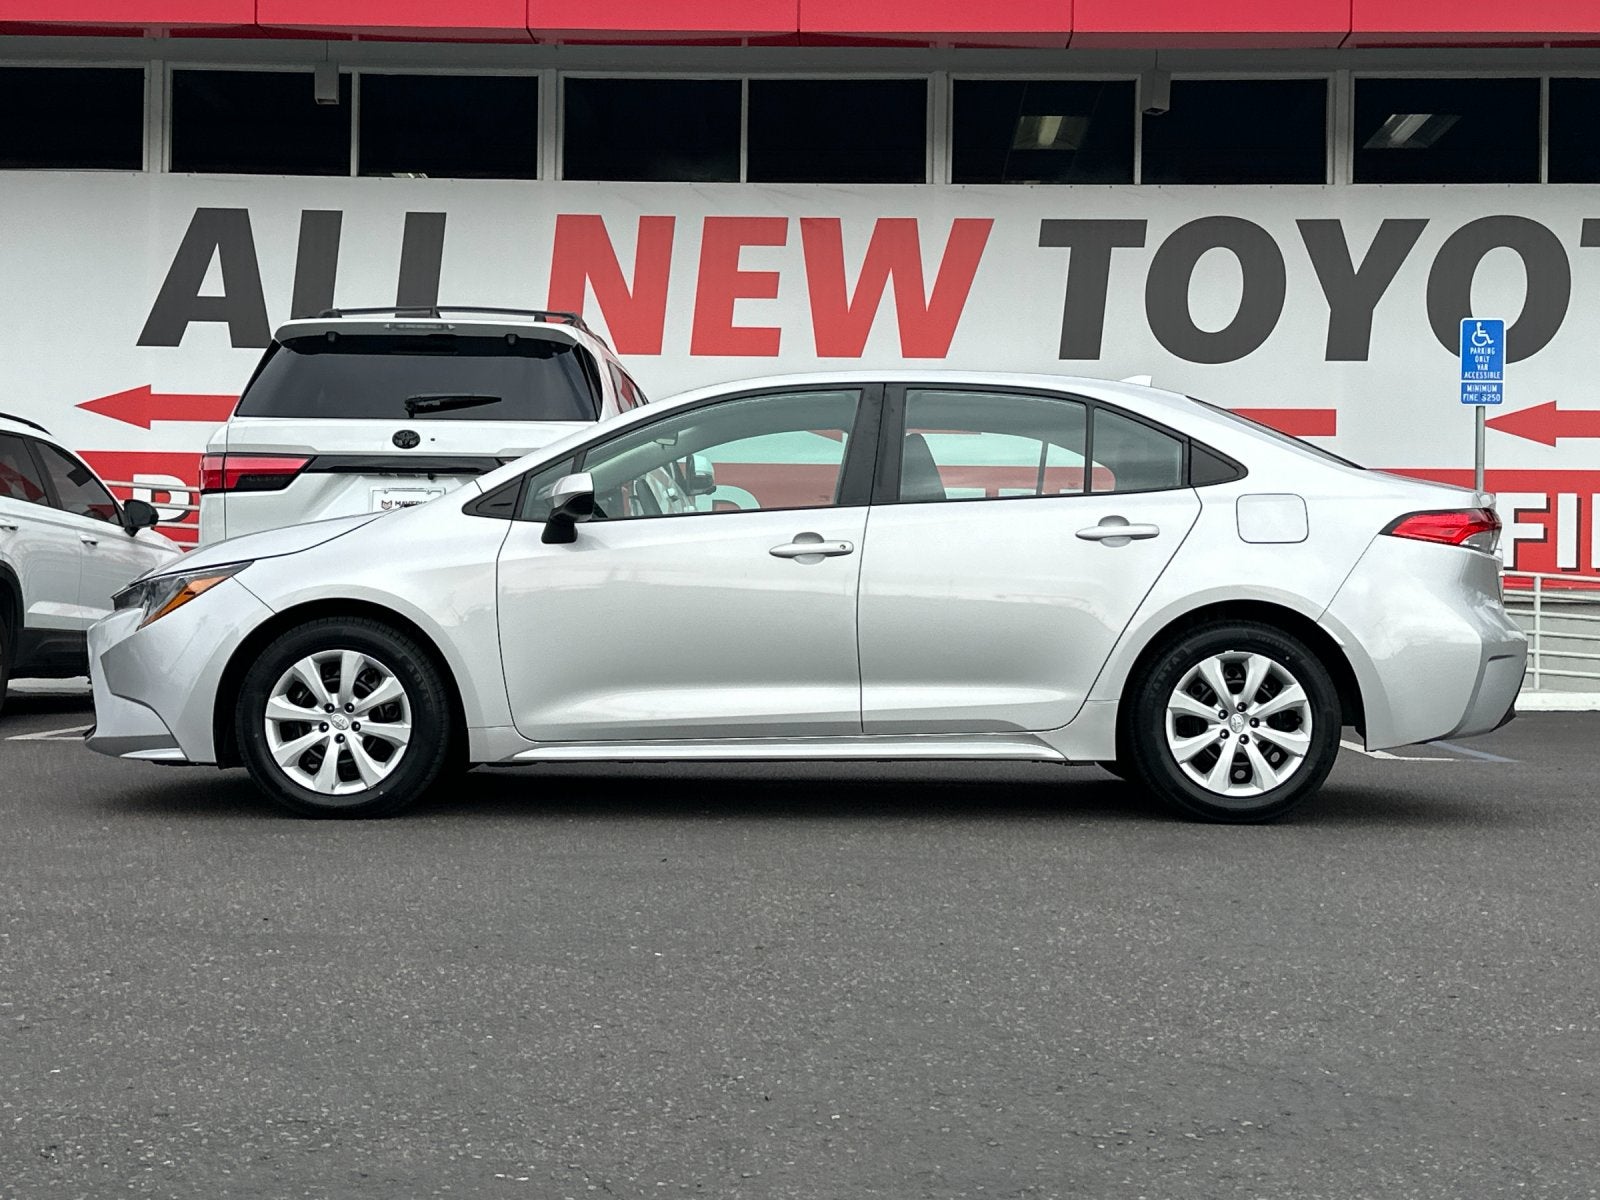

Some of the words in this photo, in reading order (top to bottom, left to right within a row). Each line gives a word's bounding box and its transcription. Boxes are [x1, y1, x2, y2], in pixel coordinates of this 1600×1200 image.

[137, 207, 447, 348] ALL
[548, 214, 993, 358] NEW
[1039, 214, 1600, 364] TOYO
[1470, 347, 1496, 355] PARKING
[1474, 355, 1491, 363] ONLY
[1477, 363, 1489, 371] VAN
[1463, 371, 1501, 379] ACCESSIBLE
[1466, 384, 1498, 393] MINIMUM
[1463, 393, 1479, 402] FINE
[1481, 393, 1501, 402] $250
[1495, 492, 1600, 571] FI
